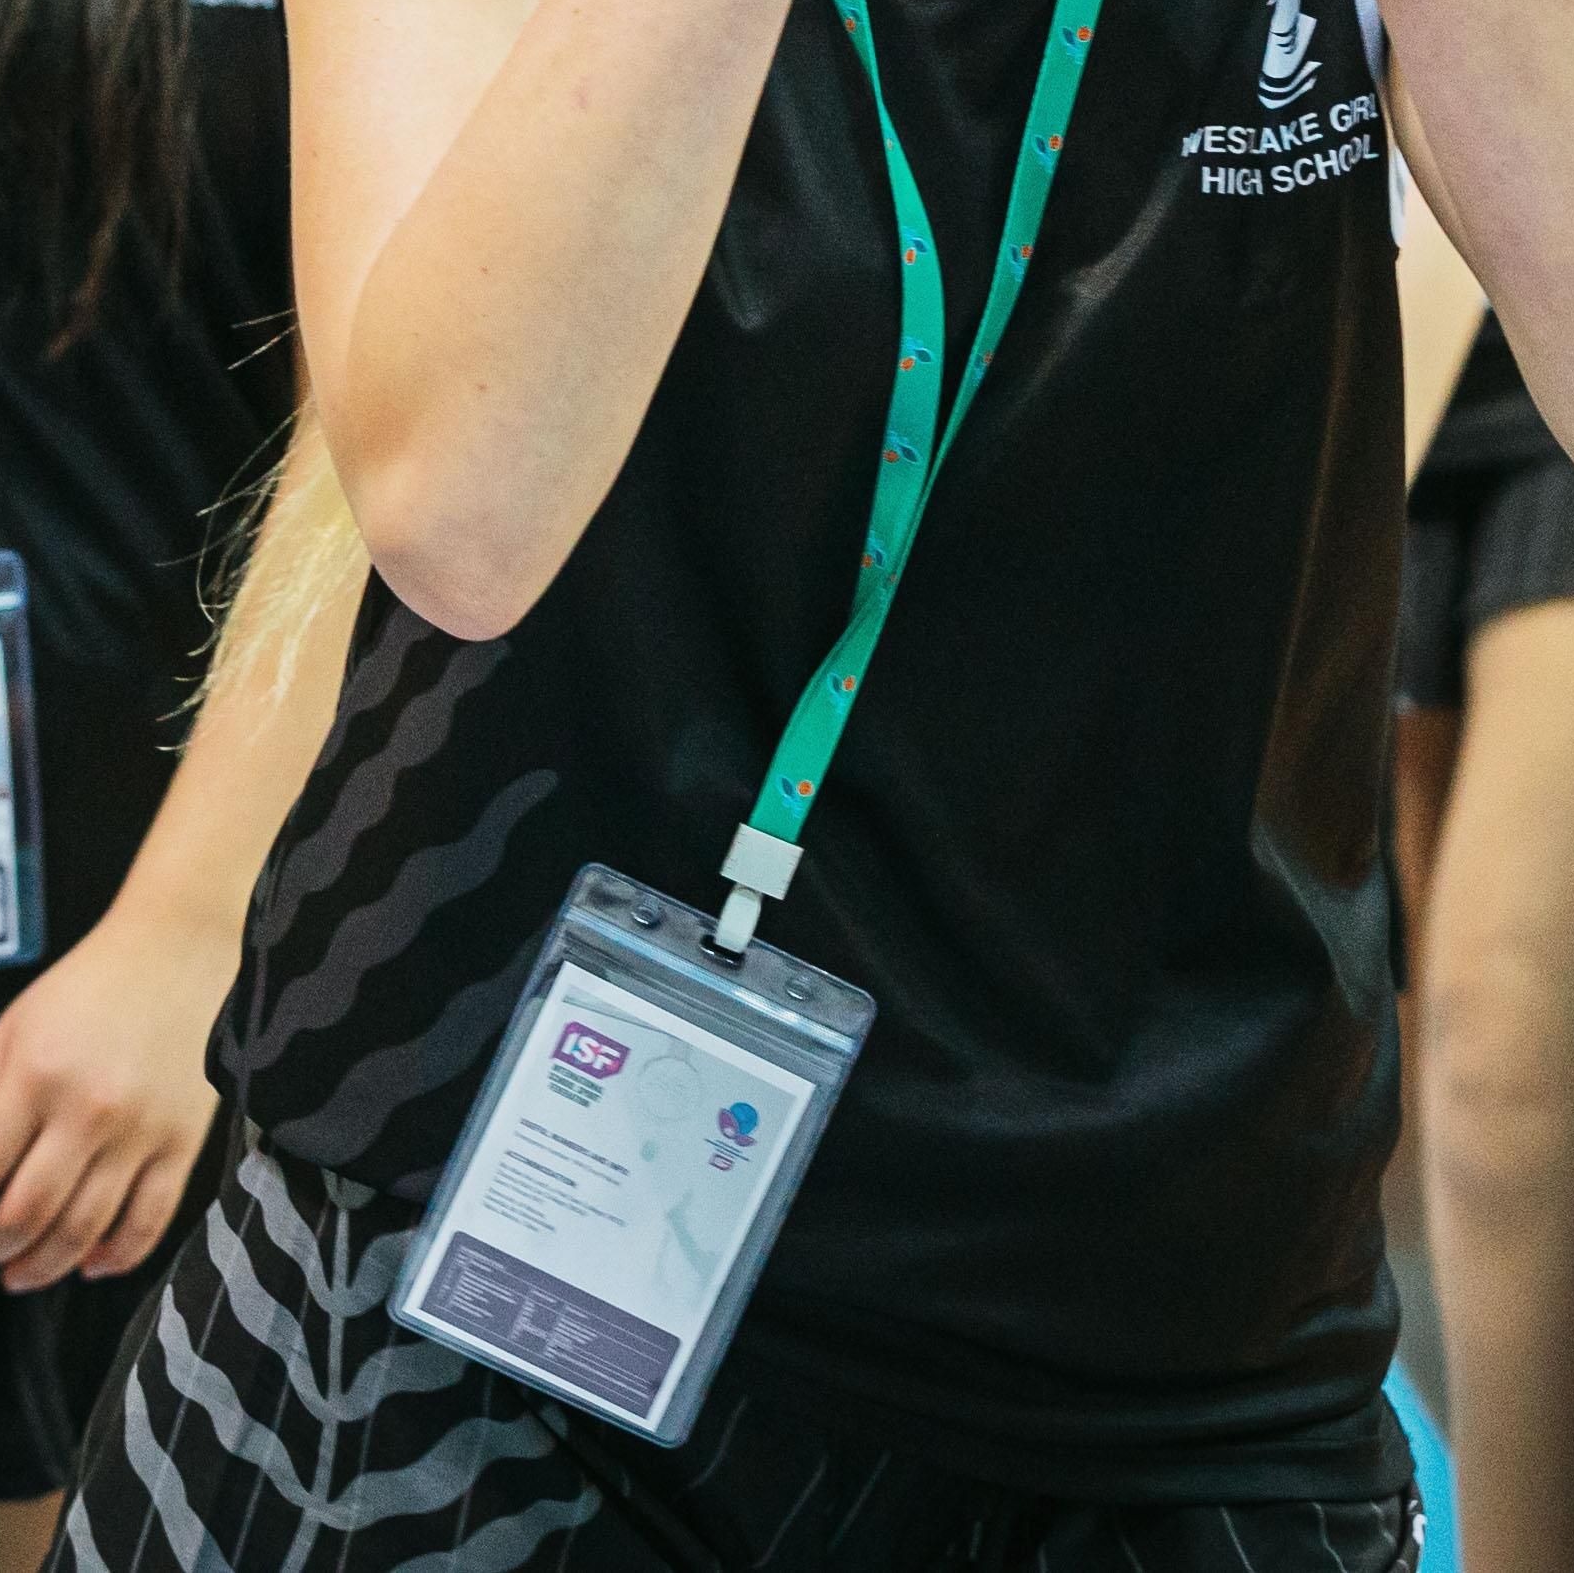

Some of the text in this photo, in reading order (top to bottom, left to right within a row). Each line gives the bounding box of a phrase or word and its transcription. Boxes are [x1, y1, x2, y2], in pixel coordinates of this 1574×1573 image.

[1201, 165, 1264, 195] HIGH
[1270, 134, 1379, 193] SCHOOL
[562, 1031, 621, 1072] ISF
